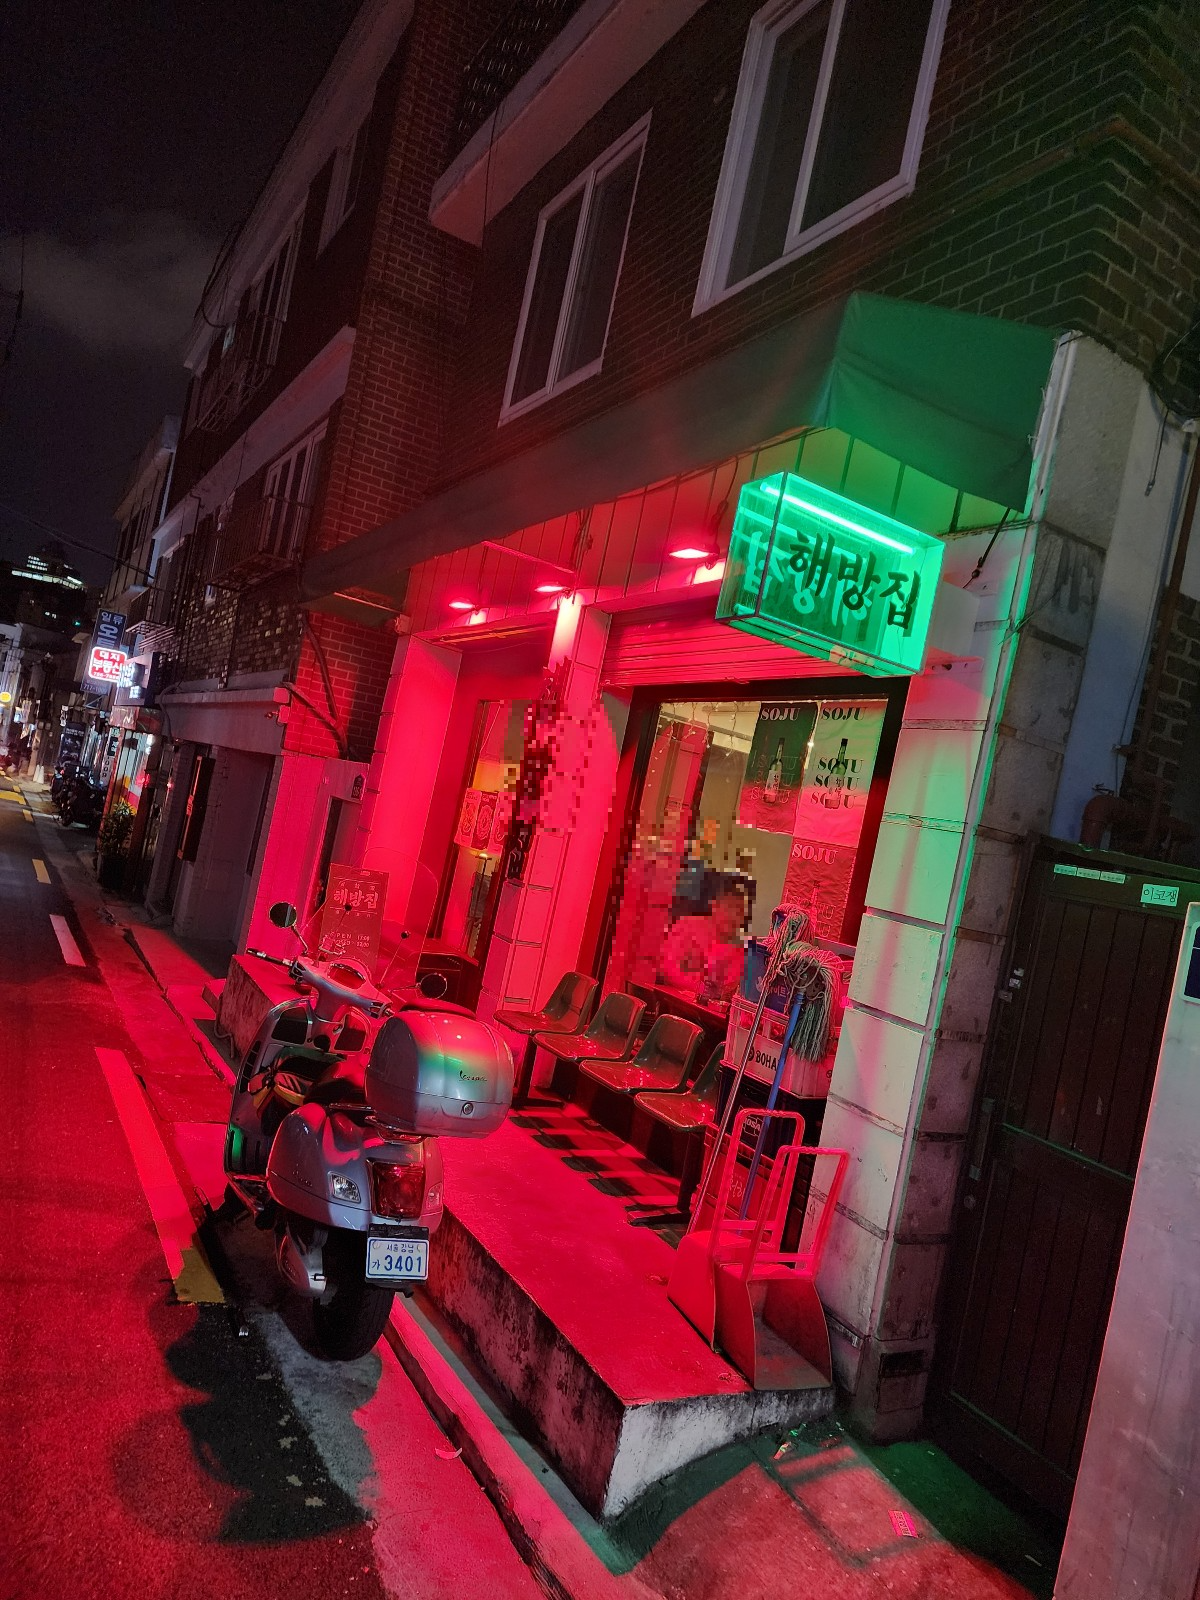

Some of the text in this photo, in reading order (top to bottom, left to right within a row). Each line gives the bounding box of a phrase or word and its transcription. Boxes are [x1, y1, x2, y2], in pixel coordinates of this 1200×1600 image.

[789, 531, 921, 630] 해방집
[99, 650, 121, 662] 대지
[93, 658, 123, 675] 부동산
[759, 707, 802, 722] SOJU
[821, 707, 866, 722] SOJU
[792, 842, 838, 866] SOJU
[333, 888, 379, 909] 해방집
[386, 1243, 414, 1254] 서울 강남
[371, 1254, 422, 1273] 가 3401
